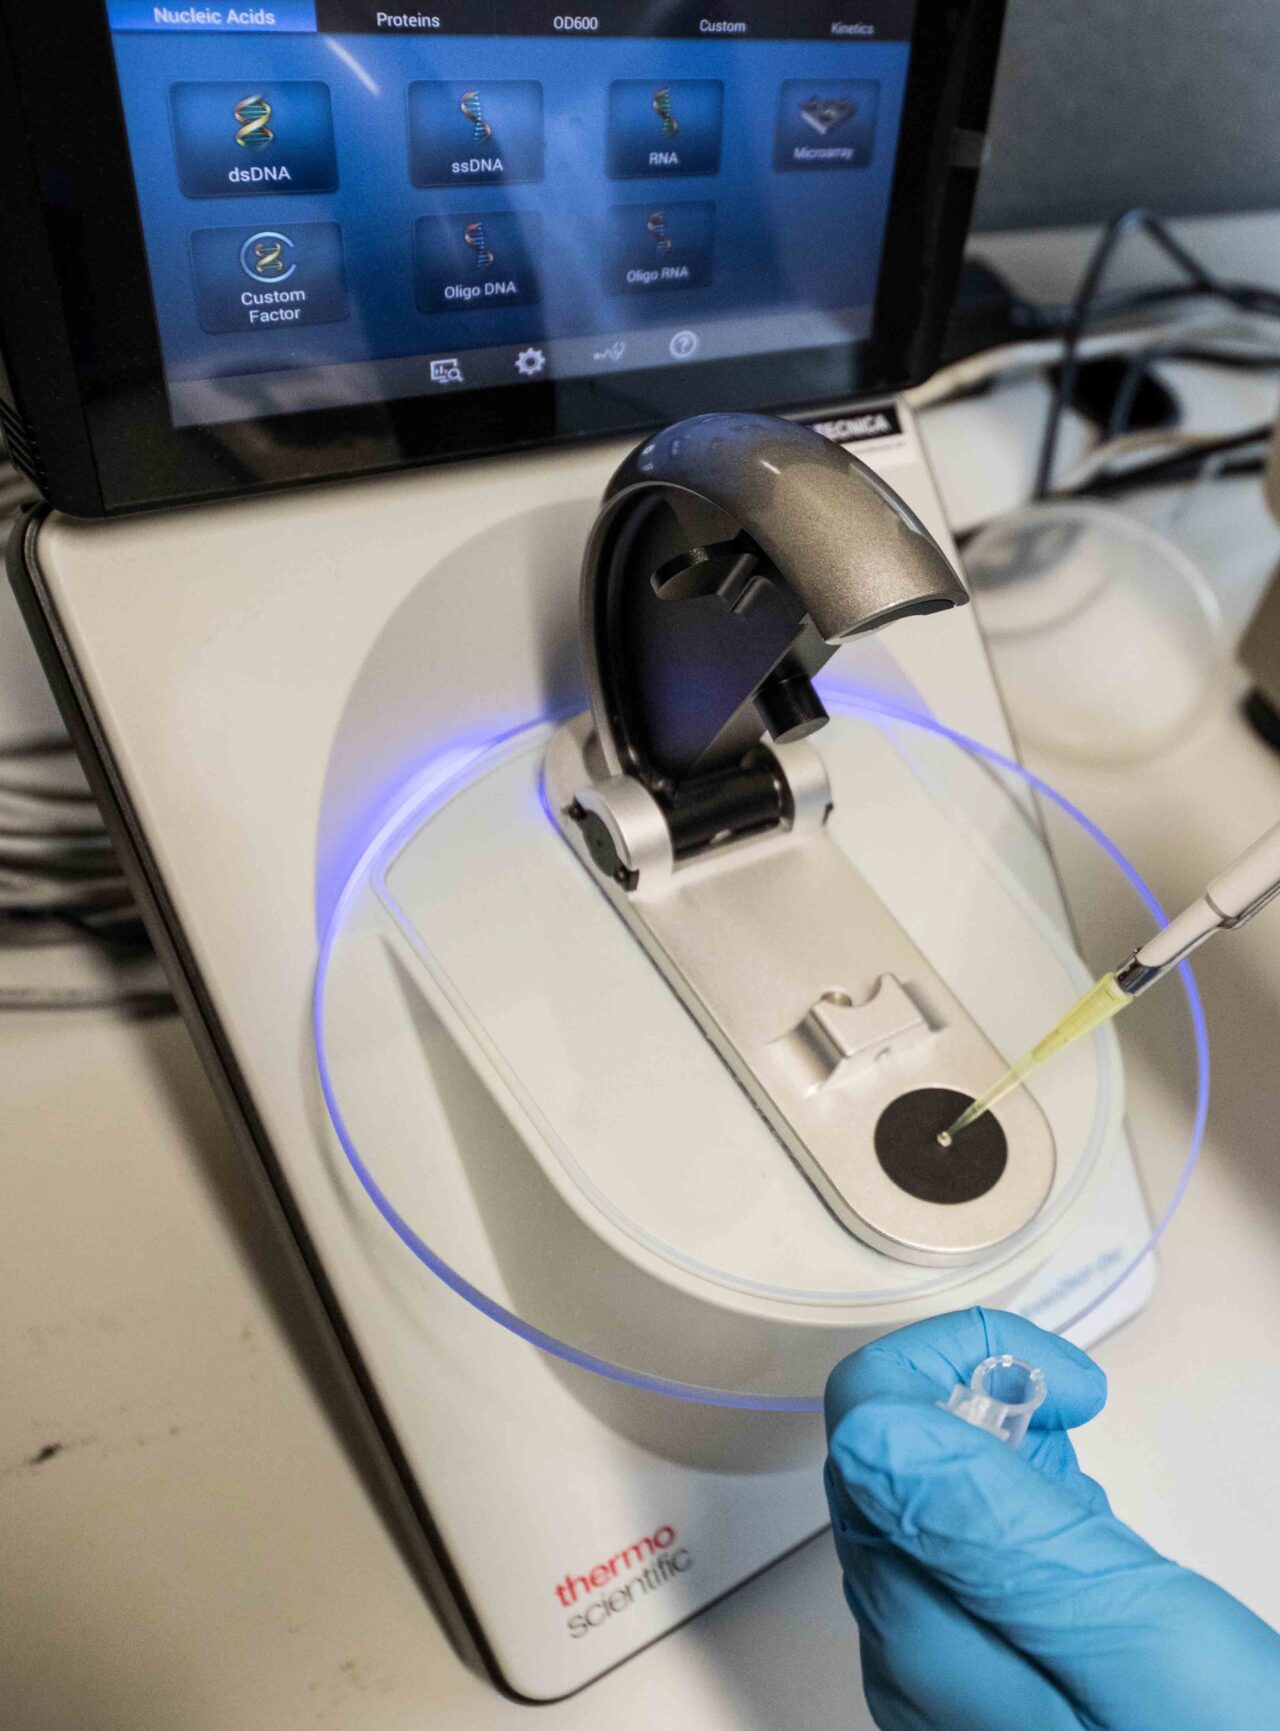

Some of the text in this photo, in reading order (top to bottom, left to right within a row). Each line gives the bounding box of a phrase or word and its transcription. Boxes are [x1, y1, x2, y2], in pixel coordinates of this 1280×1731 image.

[153, 7, 276, 26] Nucleic Acids
[376, 12, 441, 28] Proteins
[553, 16, 599, 31] OD600
[699, 19, 747, 33] Custom
[831, 22, 875, 35] Kinetics
[649, 152, 679, 166] RNA
[793, 146, 854, 160] Microarray
[451, 158, 504, 173] ssDNA
[228, 166, 291, 183] dsDNA
[627, 266, 689, 283] Oligo RNA
[241, 288, 306, 306] Custom
[444, 281, 517, 300] Oligo DNA
[249, 307, 301, 324] Factor
[555, 1525, 676, 1608] thermo
[567, 1548, 692, 1639] scientific
